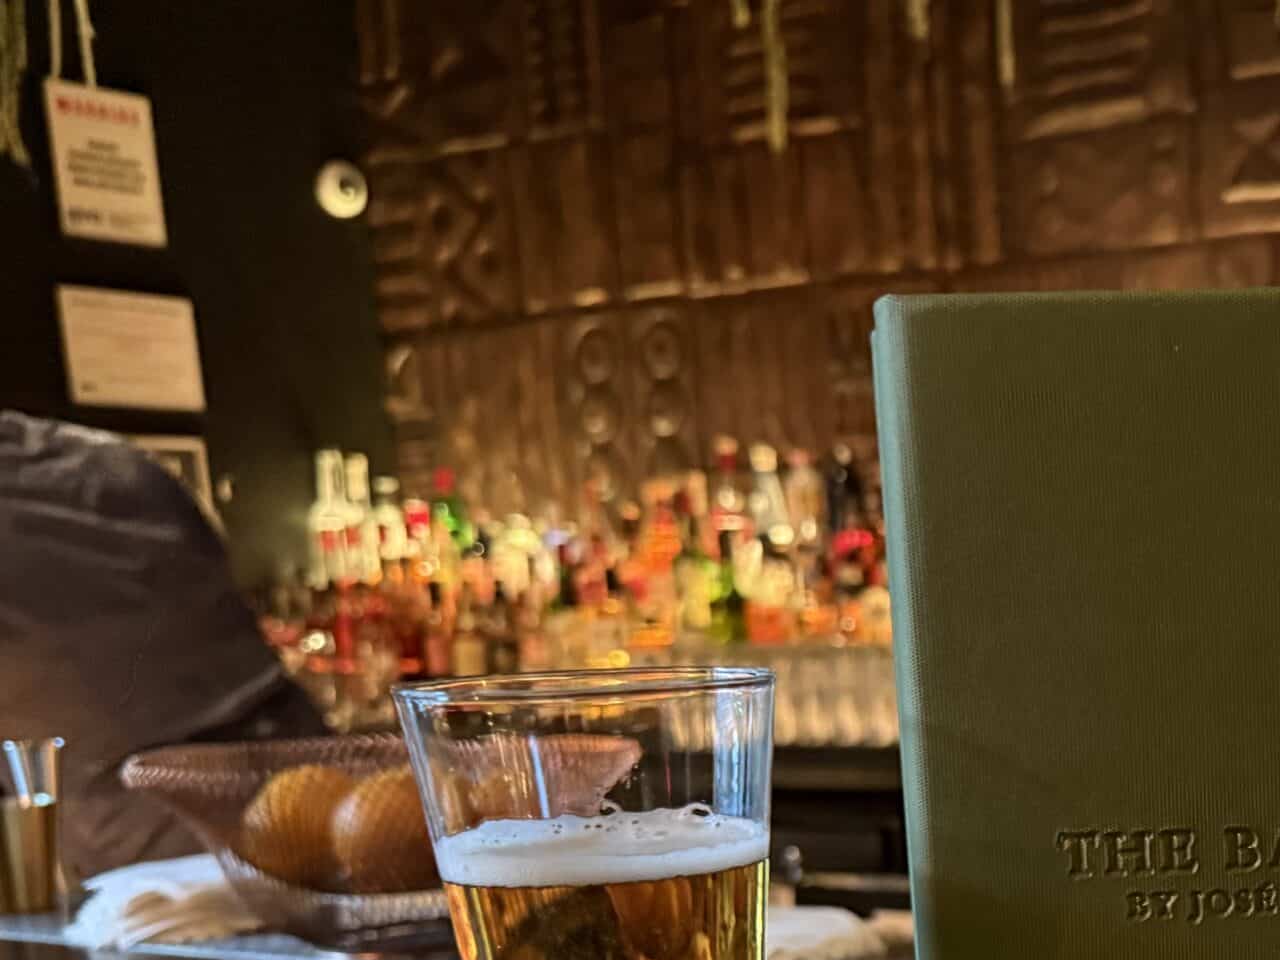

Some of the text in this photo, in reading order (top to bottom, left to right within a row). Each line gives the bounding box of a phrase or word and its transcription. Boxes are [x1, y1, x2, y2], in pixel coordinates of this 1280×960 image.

[1057, 826, 1199, 879] THE
[1125, 889, 1178, 922] BY
[1187, 883, 1279, 924] JOSÉ
